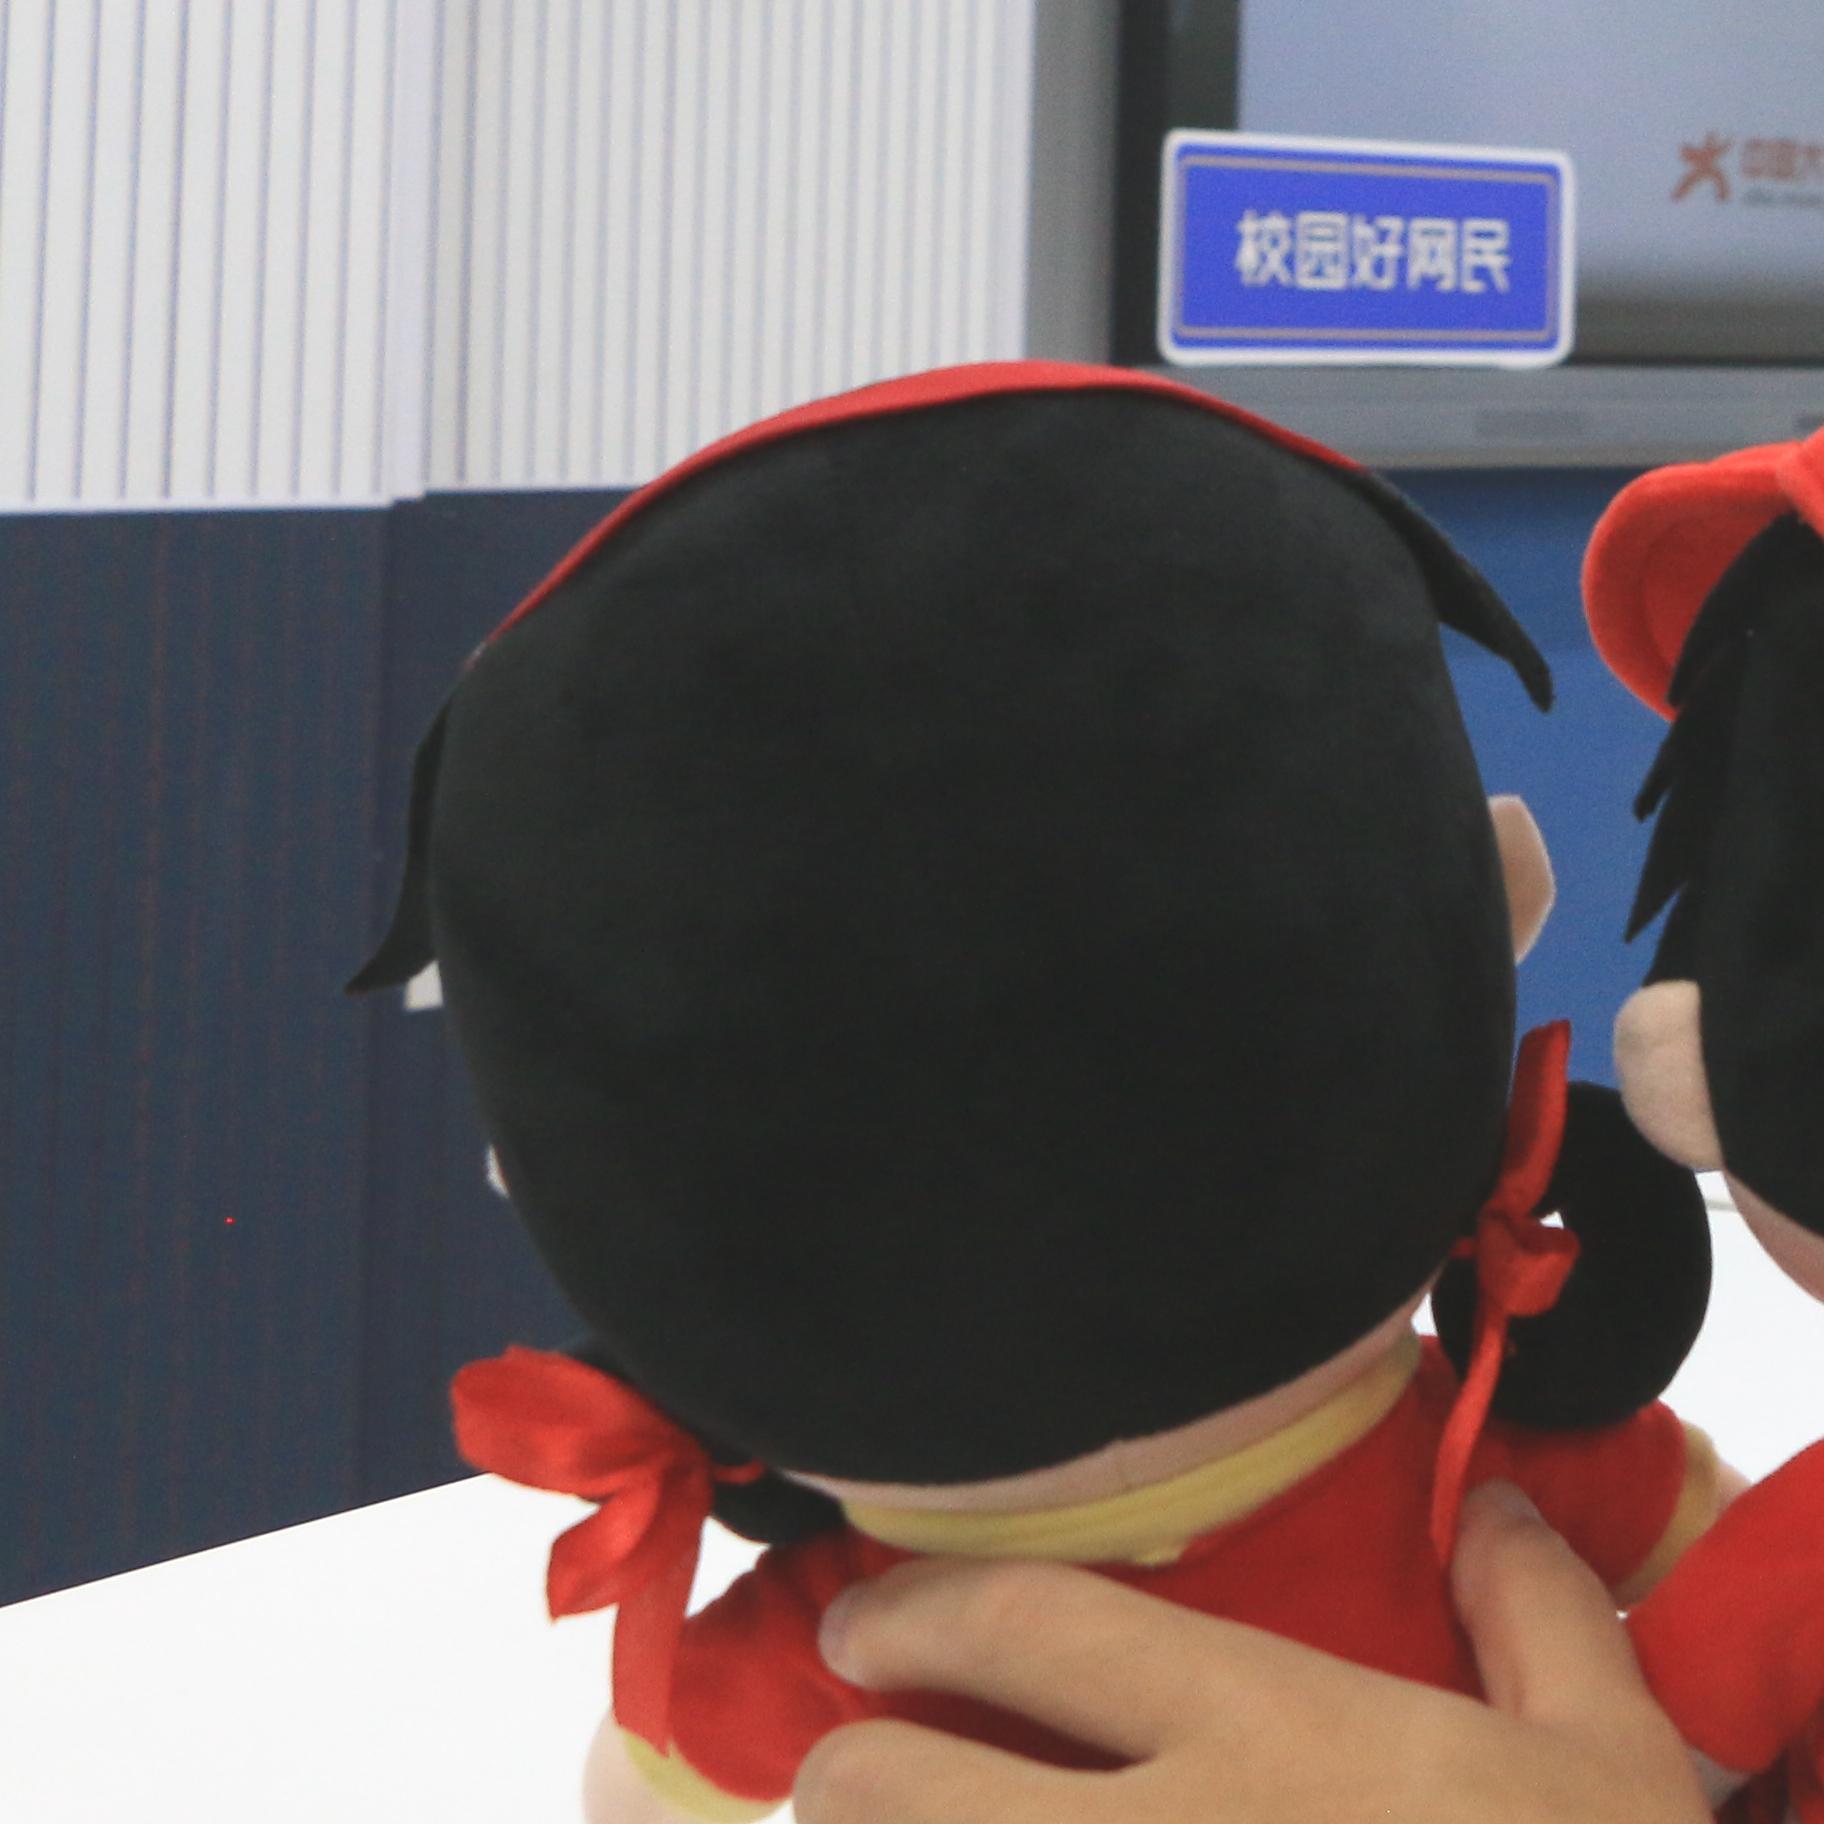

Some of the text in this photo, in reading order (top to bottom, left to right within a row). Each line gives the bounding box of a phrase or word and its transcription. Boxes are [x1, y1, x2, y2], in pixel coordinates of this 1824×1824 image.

[1235, 208, 1511, 295] 校园好网民
